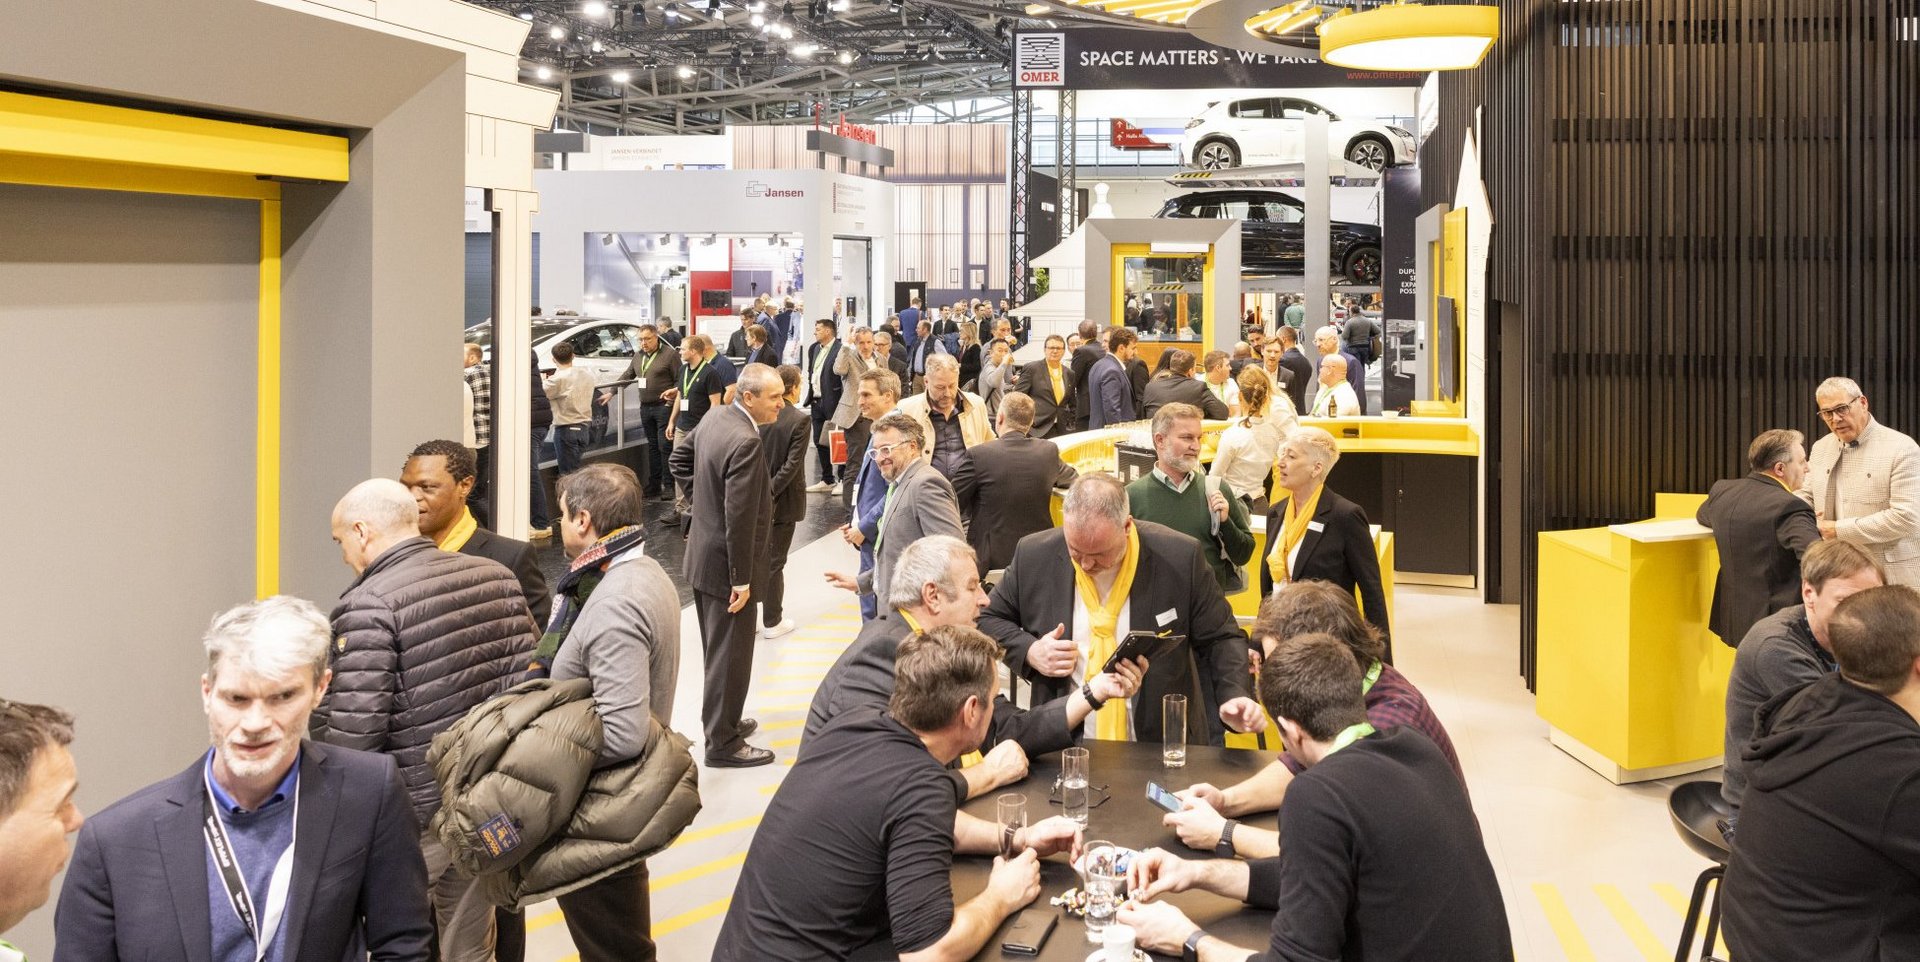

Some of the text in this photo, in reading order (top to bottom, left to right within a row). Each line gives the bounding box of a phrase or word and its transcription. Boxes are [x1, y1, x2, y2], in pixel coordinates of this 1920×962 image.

[1080, 50, 1134, 66] SPACE
[1139, 50, 1219, 65] MATTERS
[1236, 49, 1267, 64] WE
[1274, 55, 1318, 64] TA
[1021, 72, 1060, 82] OMER
[1346, 72, 1421, 80] www.omerpark
[765, 188, 804, 198] Jansen
